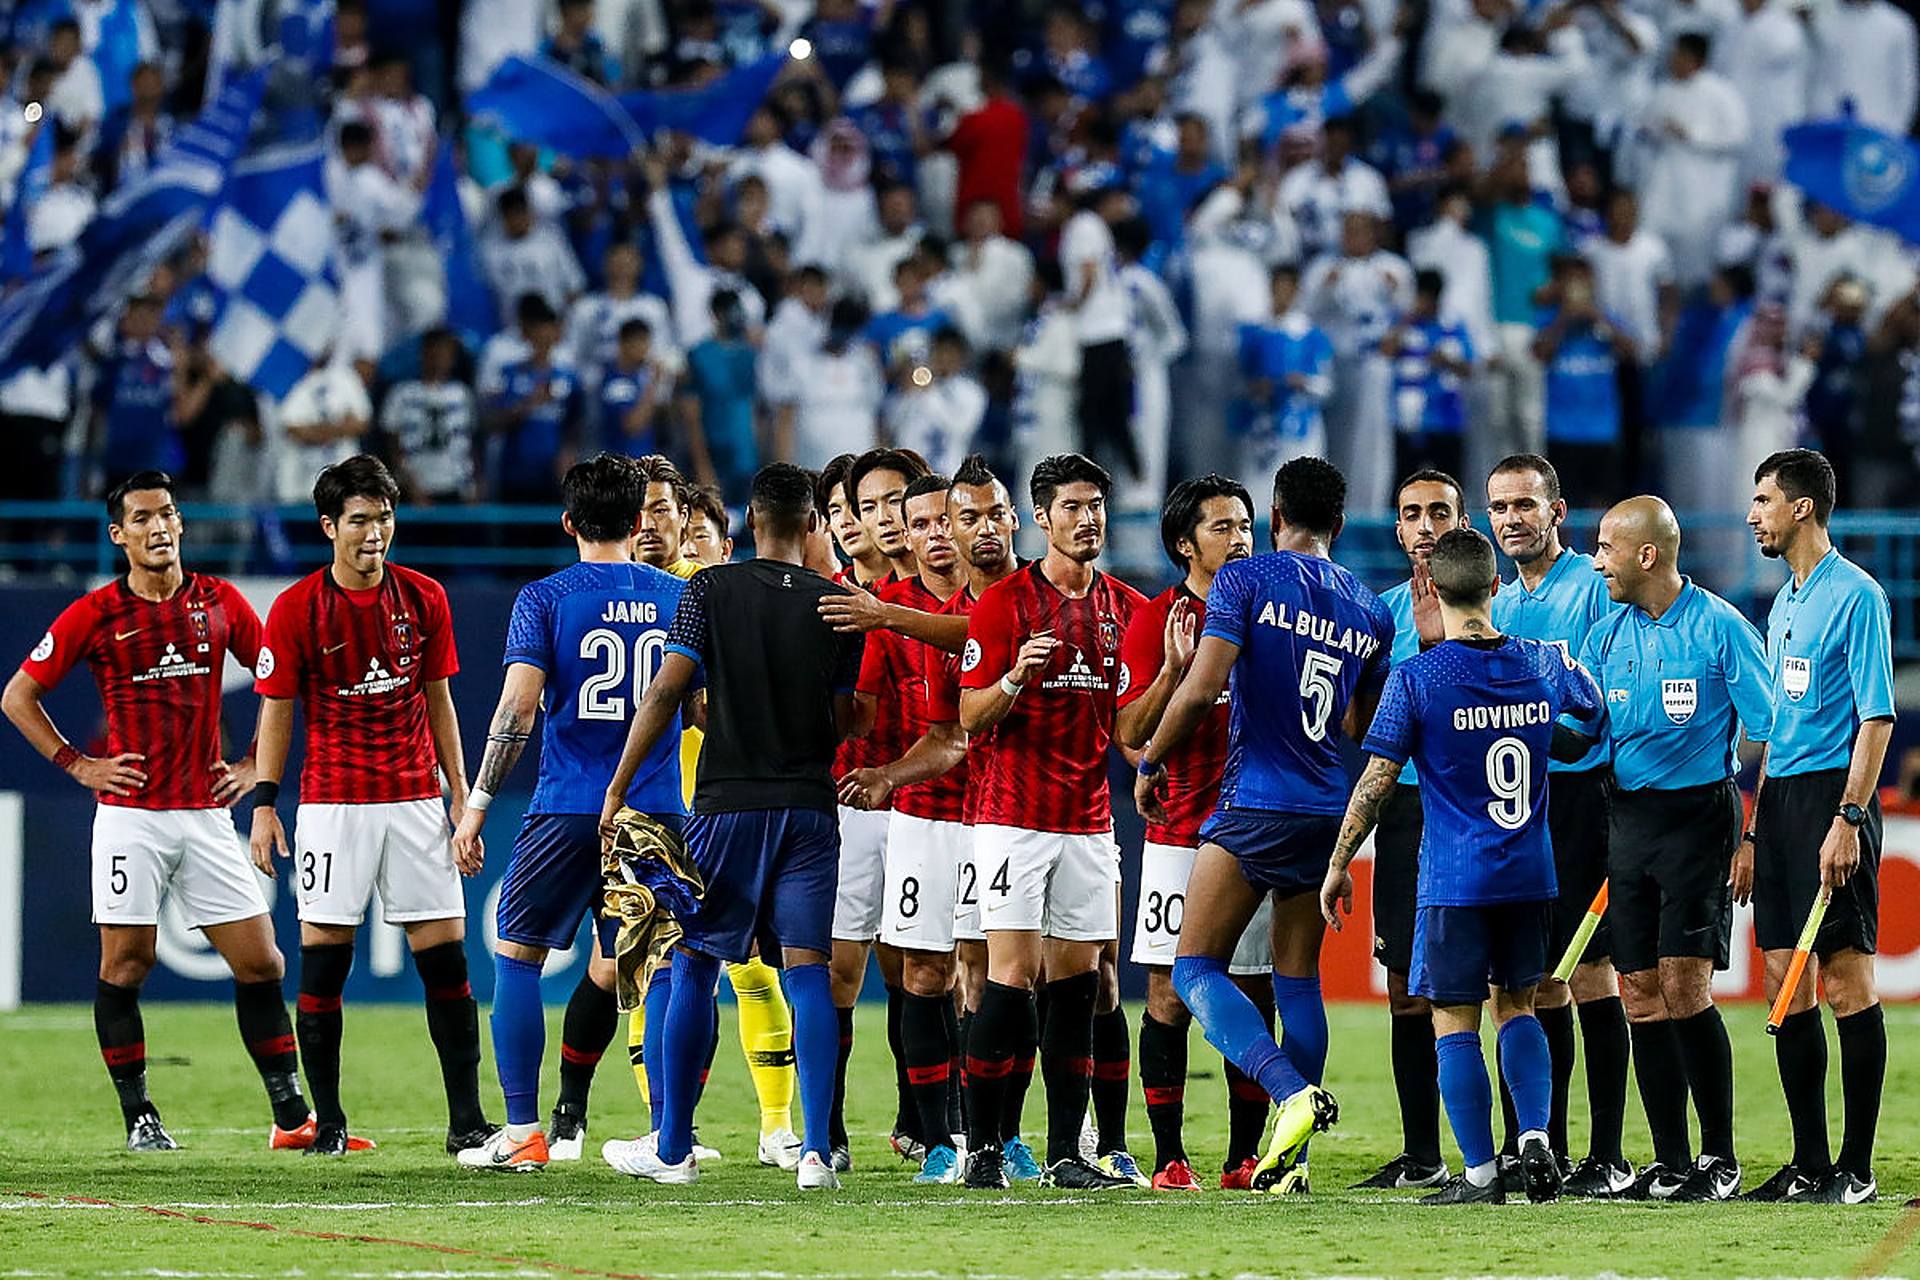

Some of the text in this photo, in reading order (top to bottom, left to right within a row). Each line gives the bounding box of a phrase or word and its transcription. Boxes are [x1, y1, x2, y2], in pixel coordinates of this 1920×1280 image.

[601, 601, 657, 623] JANG
[1257, 601, 1292, 629] AL
[578, 628, 668, 721] 20
[1785, 660, 1806, 671] FIFA
[1299, 649, 1343, 742] 5
[1665, 683, 1694, 693] FIFA
[1453, 700, 1550, 730] GIOVINCO
[1486, 737, 1531, 830] 9
[111, 856, 128, 895] 5
[302, 851, 333, 893] 31
[989, 856, 1012, 896] 4
[900, 876, 919, 918] 8
[1145, 891, 1184, 935] 30
